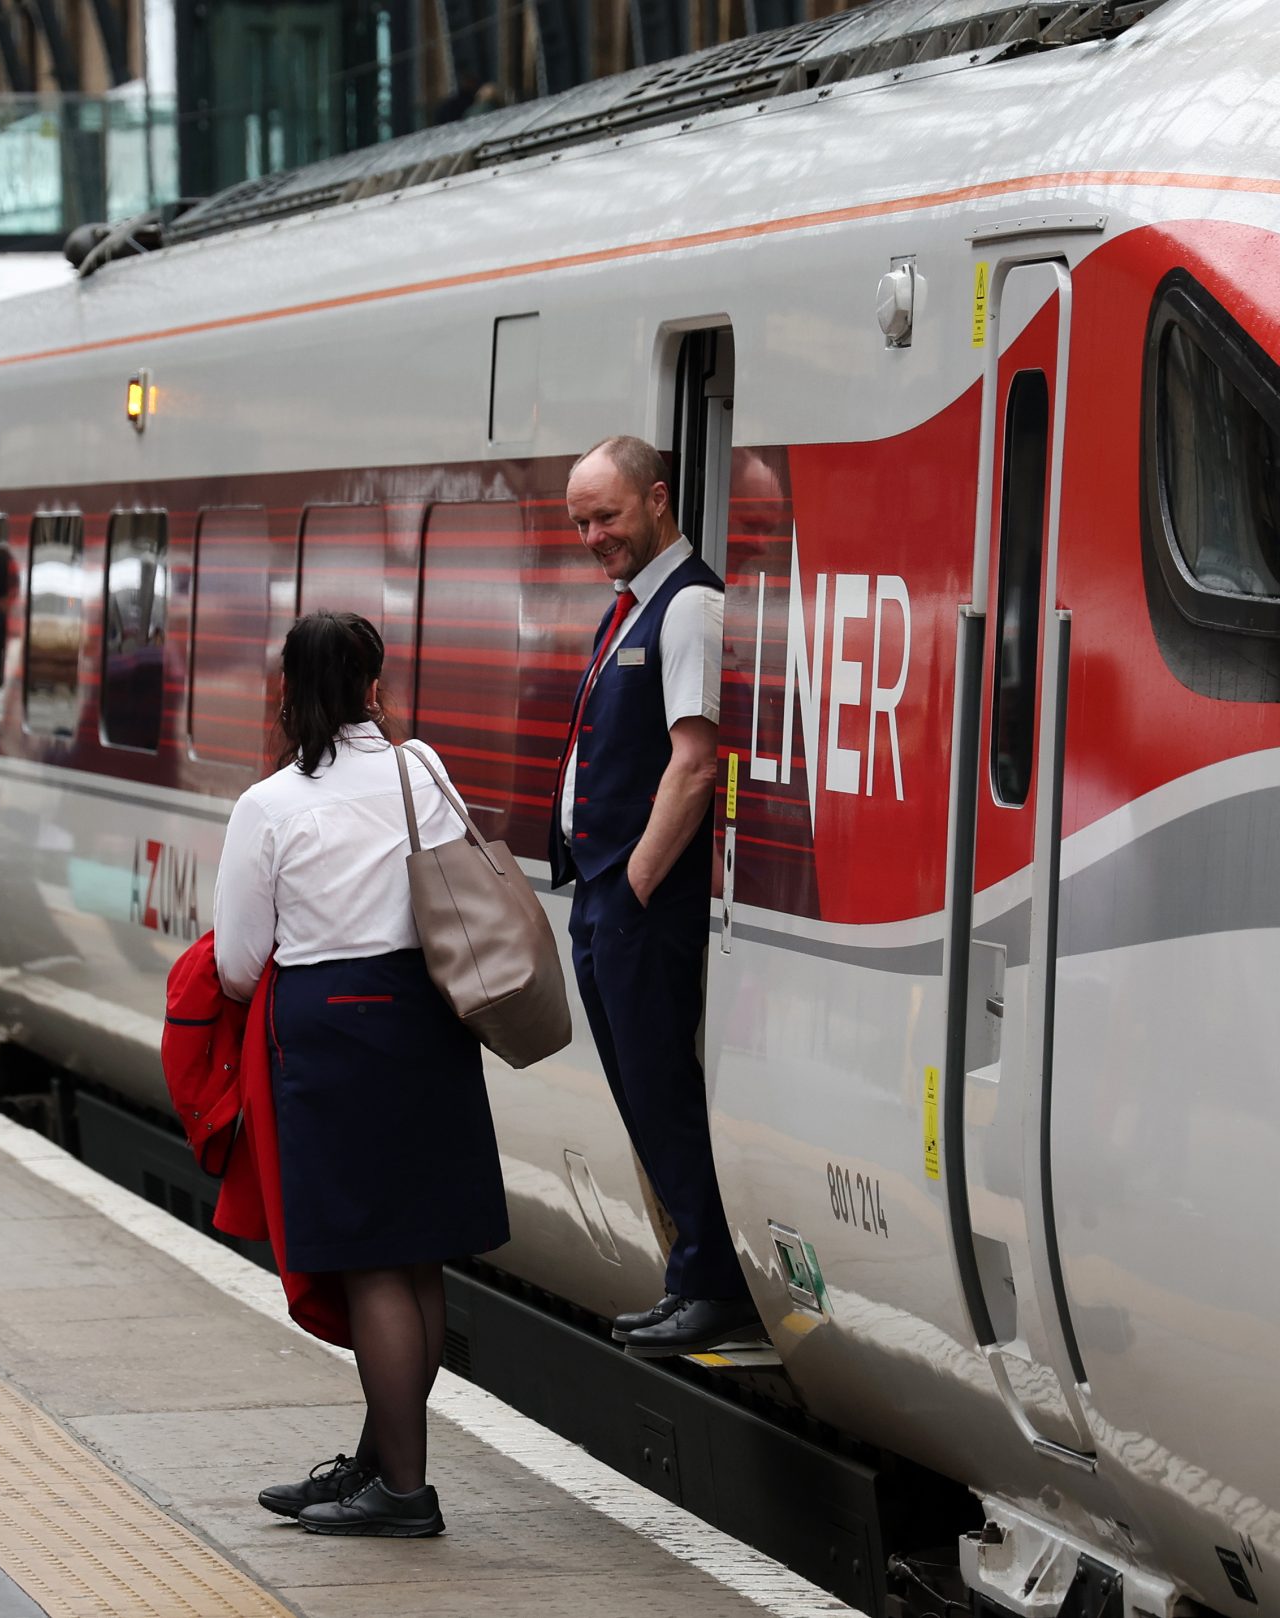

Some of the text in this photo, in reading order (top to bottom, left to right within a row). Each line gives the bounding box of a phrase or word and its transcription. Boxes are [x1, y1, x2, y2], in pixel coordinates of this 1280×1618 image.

[749, 517, 912, 840] LNER
[129, 837, 200, 941] AZUMA
[826, 1161, 889, 1239] 801 214
